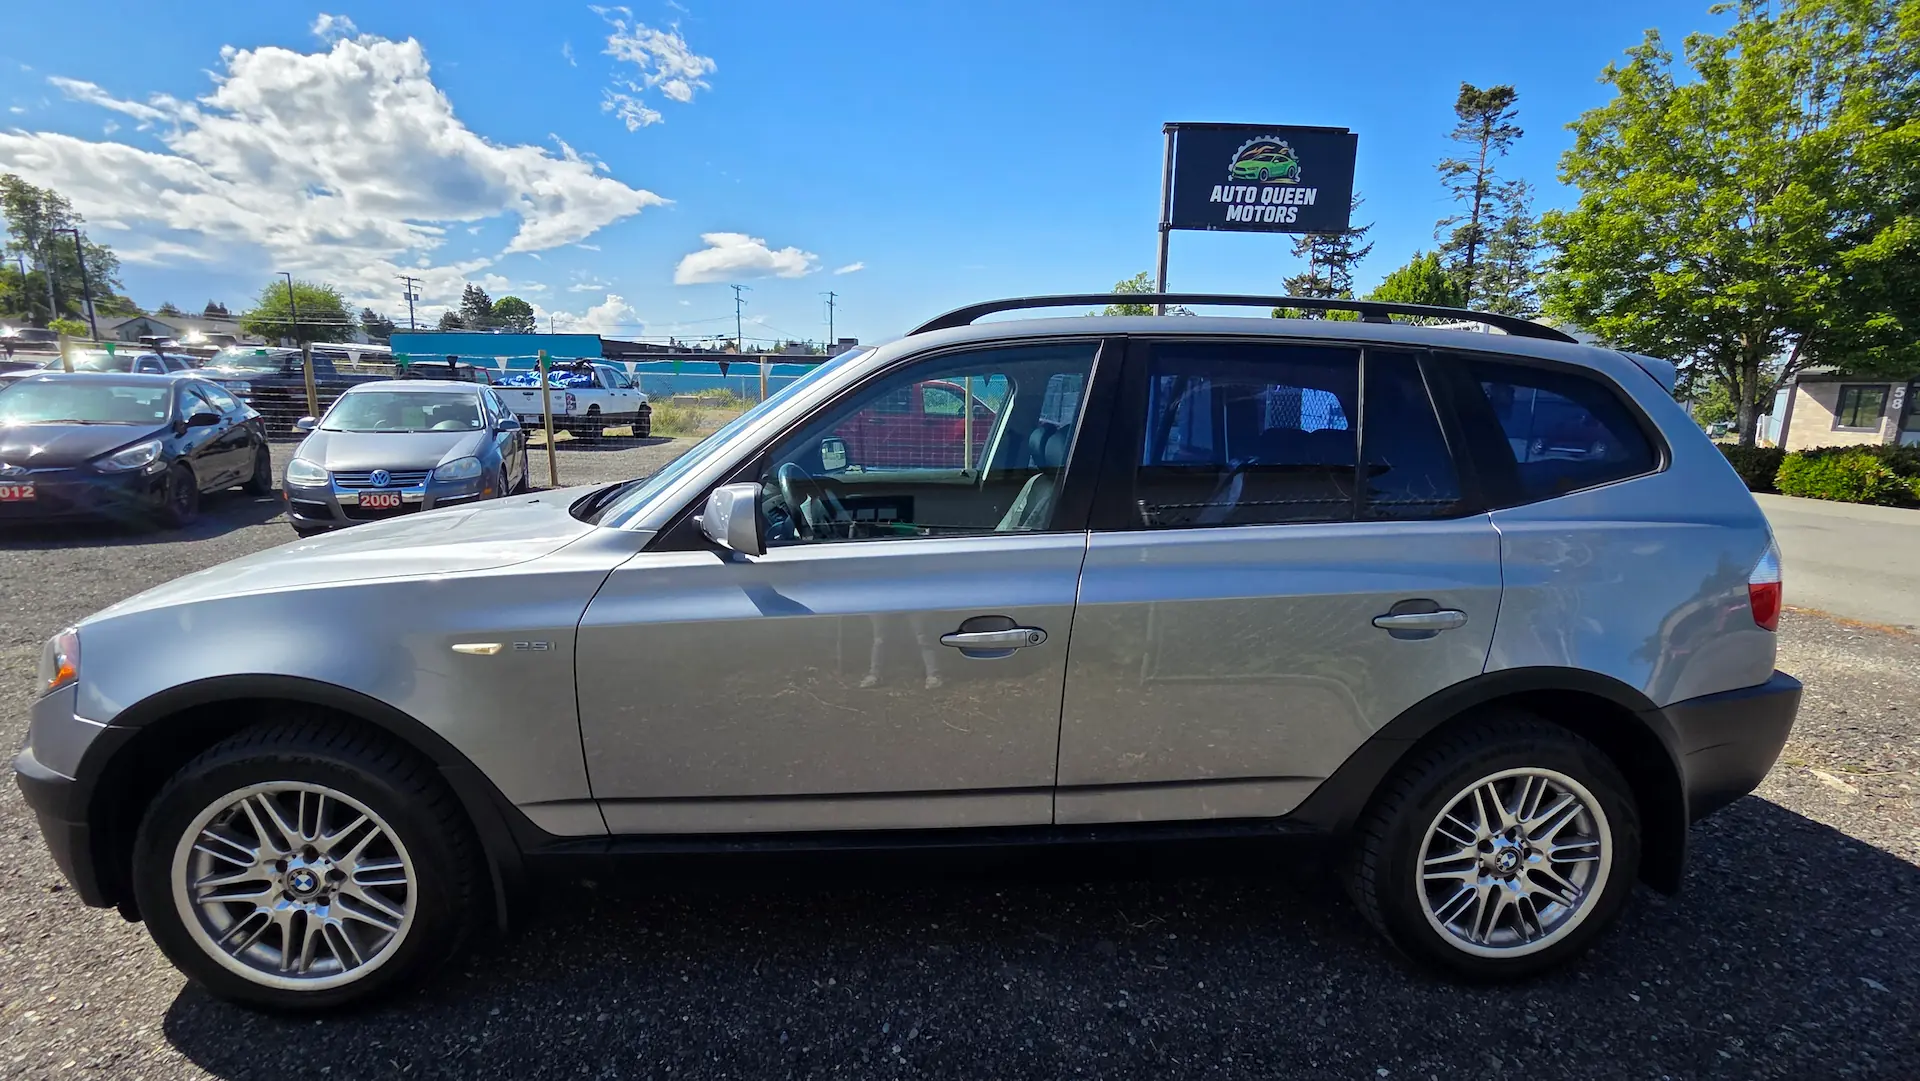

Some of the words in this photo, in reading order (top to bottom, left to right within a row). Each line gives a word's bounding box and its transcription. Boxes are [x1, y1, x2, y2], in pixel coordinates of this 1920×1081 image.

[1210, 185, 1257, 203] AUTO
[1260, 187, 1317, 205] QUEEN
[1225, 205, 1299, 223] MOTORS
[1892, 386, 1906, 409] 58
[0, 486, 34, 498] 012
[360, 494, 400, 507] 2006
